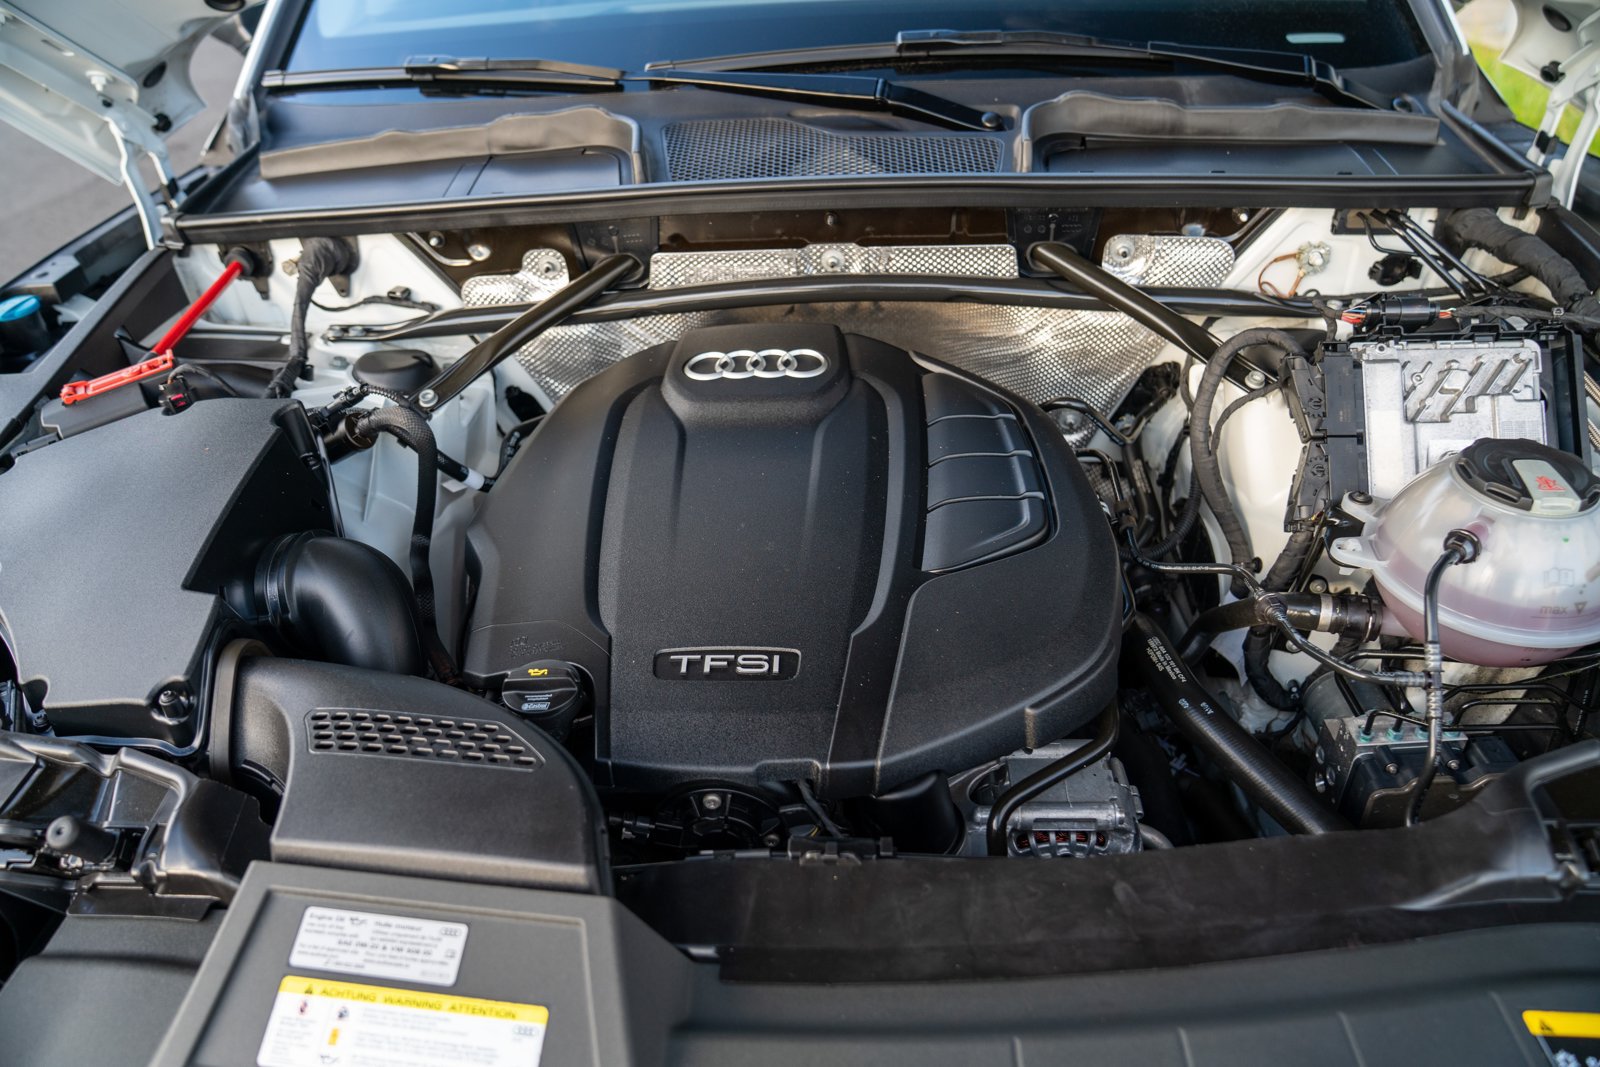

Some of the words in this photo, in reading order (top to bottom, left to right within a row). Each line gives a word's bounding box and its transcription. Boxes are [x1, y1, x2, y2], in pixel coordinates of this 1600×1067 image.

[1540, 606, 1568, 615] max
[670, 655, 780, 674] TFSI
[320, 987, 378, 1002] ACHTUNG
[383, 996, 443, 1011] WARNING
[448, 1004, 519, 1020] ATTENTION
